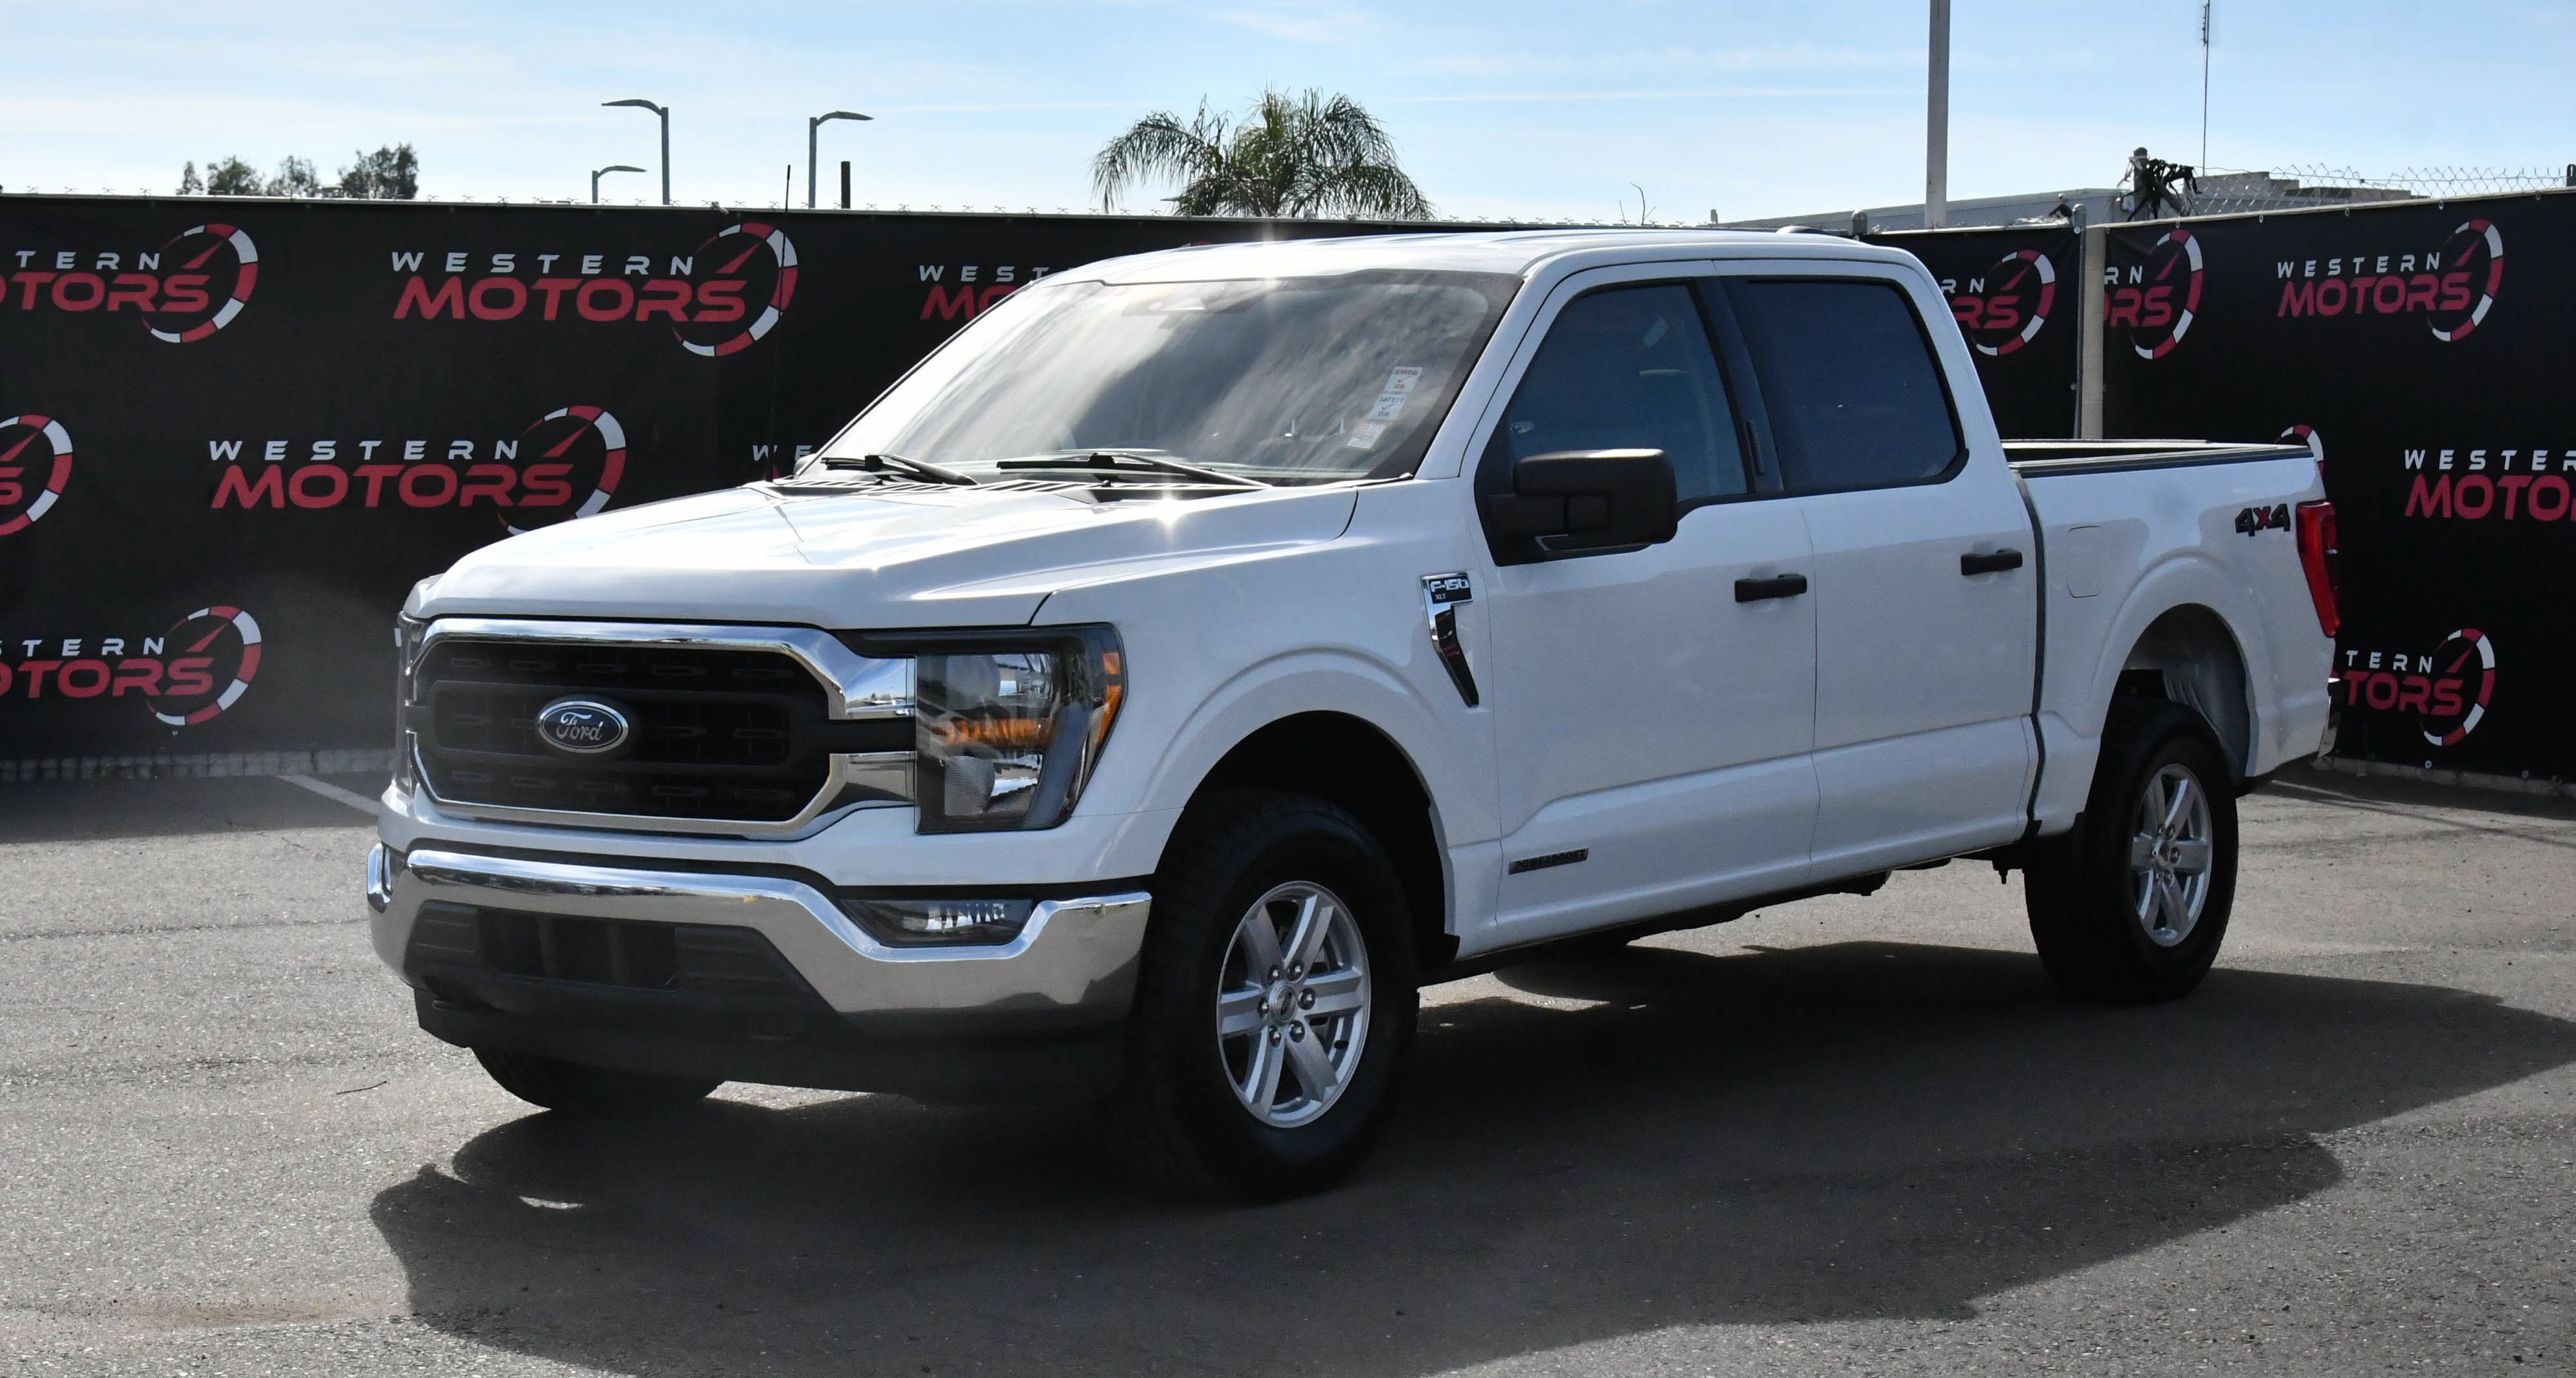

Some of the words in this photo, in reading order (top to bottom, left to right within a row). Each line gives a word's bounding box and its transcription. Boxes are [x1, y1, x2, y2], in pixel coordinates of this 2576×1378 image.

[391, 252, 693, 275] WESTERN
[919, 265, 1077, 282] WEST
[2277, 252, 2440, 279] WESTERN
[0, 271, 209, 313] TORS
[393, 276, 748, 322] MOTORS
[2278, 272, 2472, 317] MOTORS
[209, 440, 519, 461] WESTERN
[211, 464, 573, 509] MOTORS
[2404, 474, 2576, 521] MOTO
[1430, 579, 1469, 592] F-150
[0, 637, 165, 657] TERN
[0, 657, 213, 698] TORS
[2330, 669, 2463, 716] TORS
[556, 712, 604, 741] Ford
